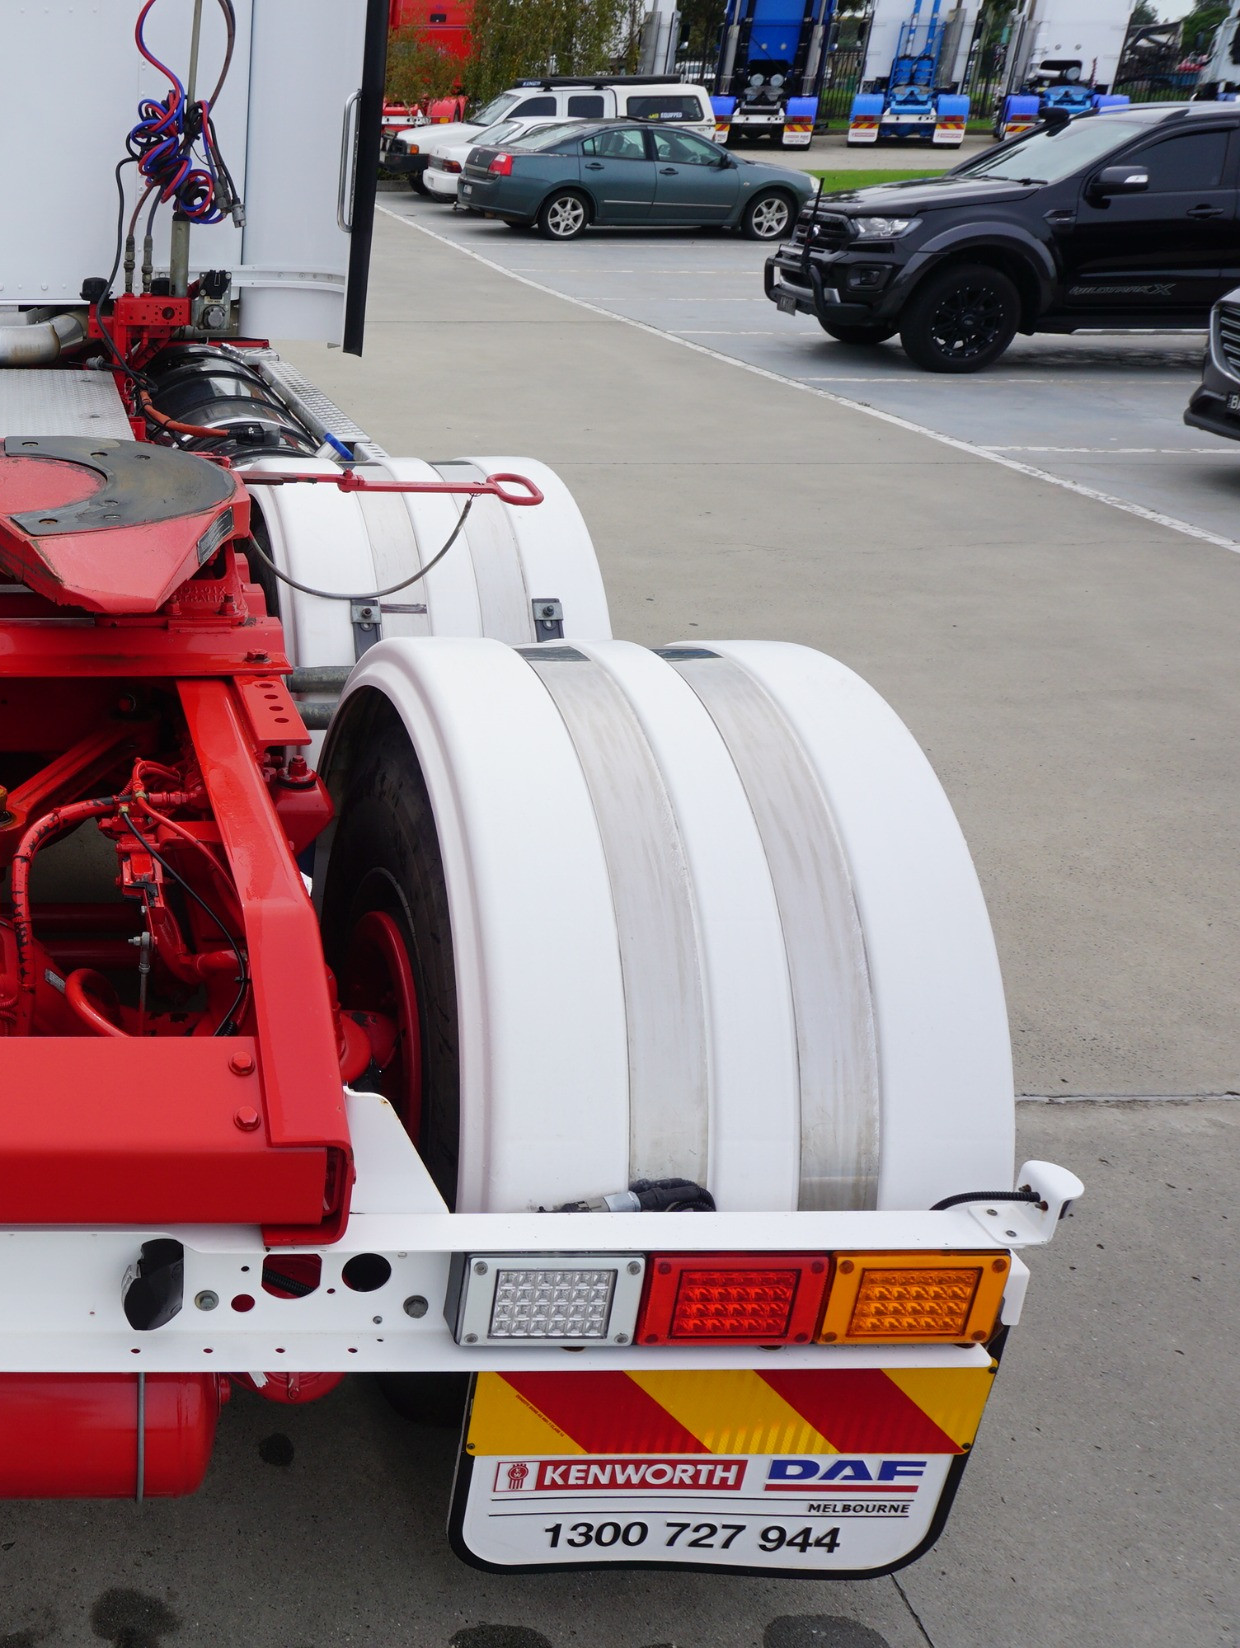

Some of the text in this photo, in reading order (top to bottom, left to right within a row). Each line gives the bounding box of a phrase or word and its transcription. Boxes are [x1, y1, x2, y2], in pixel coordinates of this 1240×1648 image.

[544, 1464, 738, 1486] KENWORTH
[768, 1460, 927, 1481] DAF
[807, 1503, 911, 1514] MELBOURNE
[544, 1521, 841, 1554] 1300 727 944
